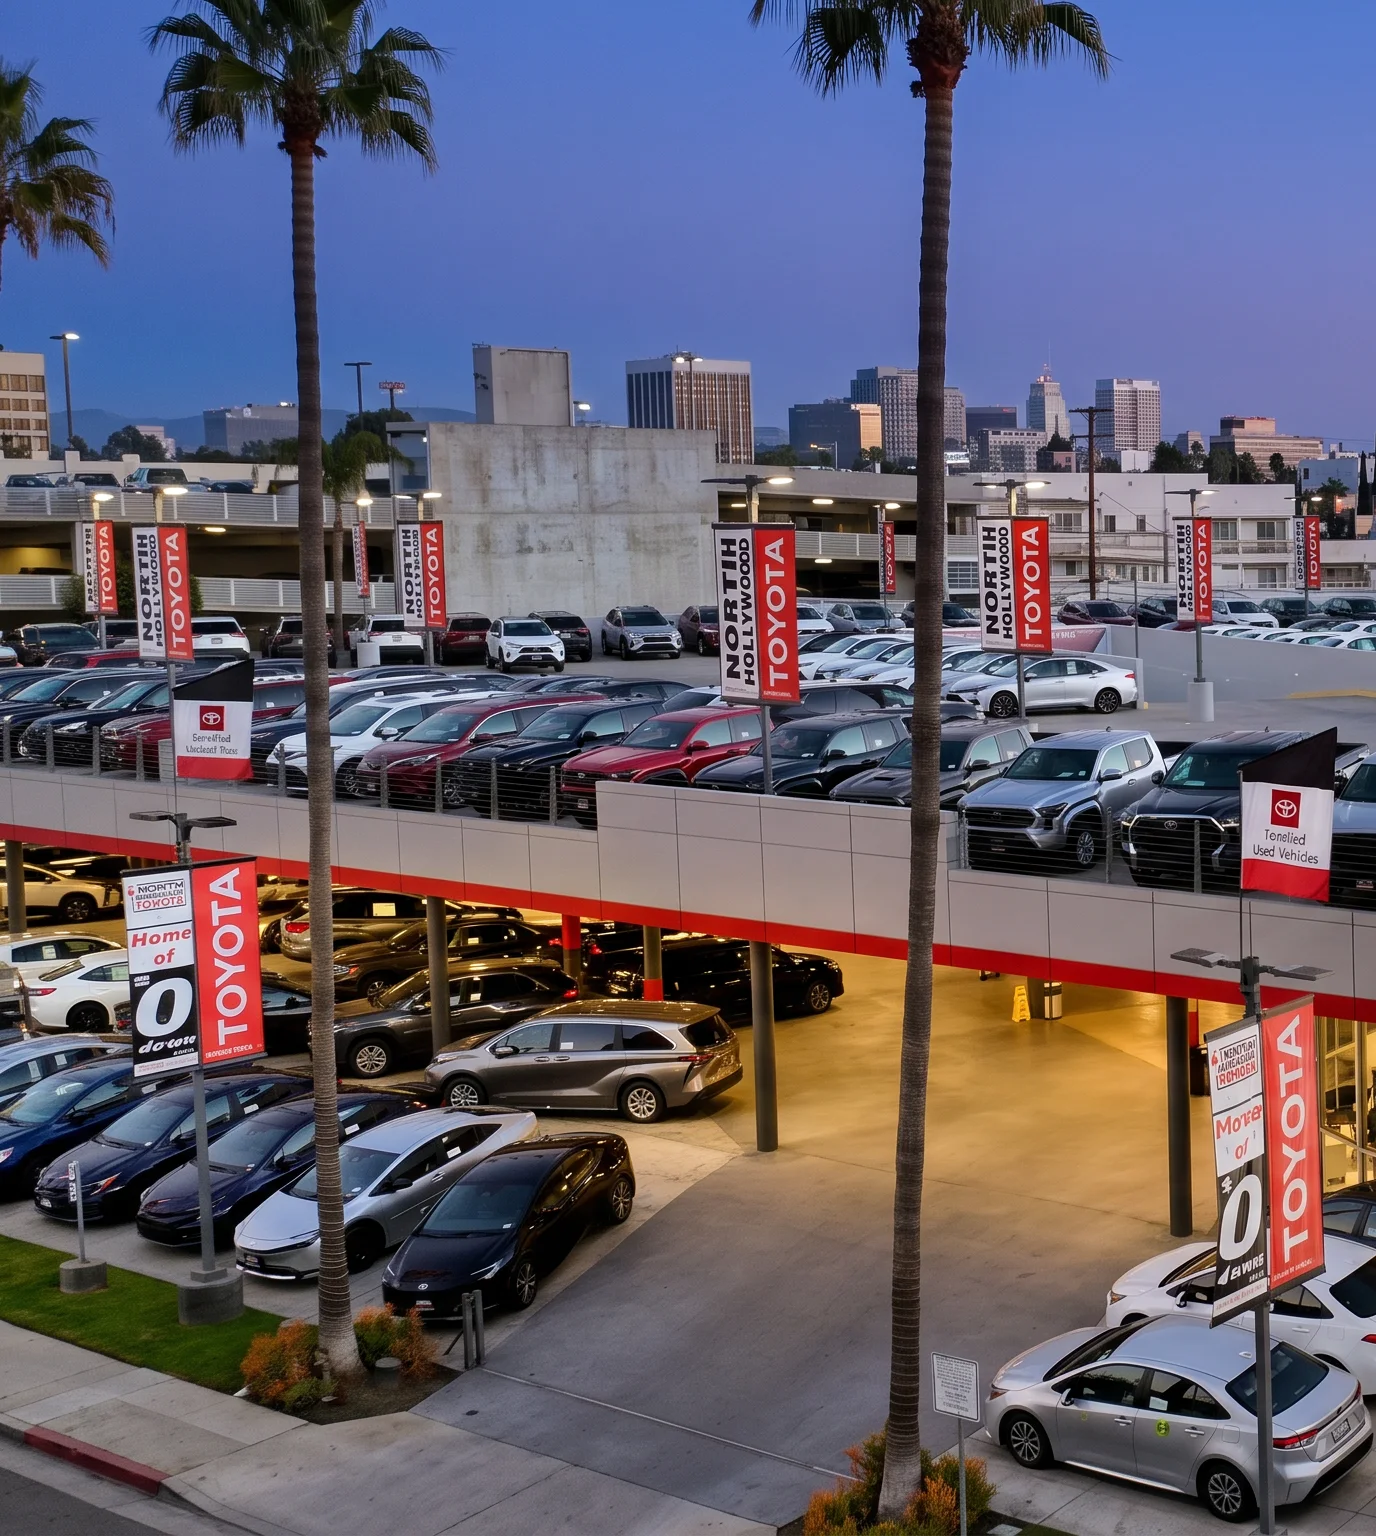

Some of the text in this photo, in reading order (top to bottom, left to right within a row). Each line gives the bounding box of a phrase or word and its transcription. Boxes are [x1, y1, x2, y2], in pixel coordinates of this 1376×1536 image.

[98, 526, 113, 603] TOYOTA
[165, 533, 187, 646] TOYOTA
[426, 527, 441, 618] TOYOTA
[1022, 526, 1042, 640] TOYOTA
[1197, 524, 1209, 612] TOYOTA
[764, 537, 789, 687] TOYOTA
[1253, 844, 1275, 858] Used
[131, 928, 191, 948] Home
[154, 948, 175, 965] of
[209, 867, 248, 1046] TOYOTA
[136, 977, 192, 1037] 0
[1276, 1015, 1308, 1263] TOYOTA
